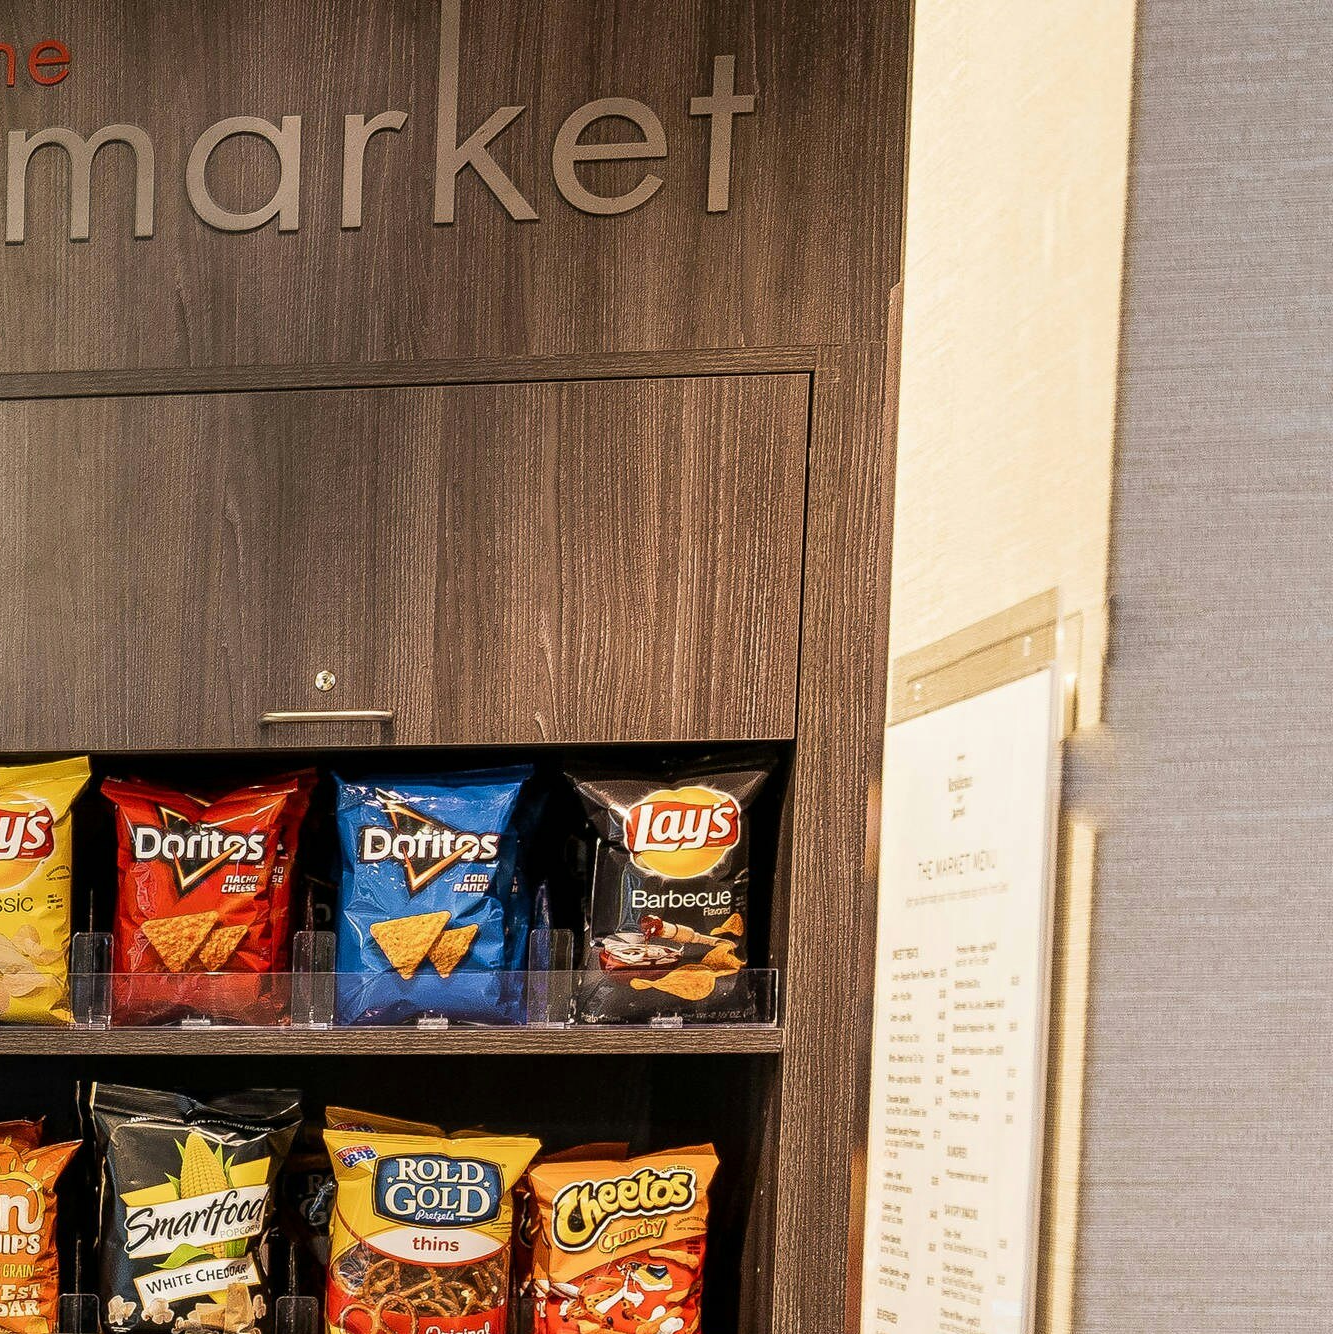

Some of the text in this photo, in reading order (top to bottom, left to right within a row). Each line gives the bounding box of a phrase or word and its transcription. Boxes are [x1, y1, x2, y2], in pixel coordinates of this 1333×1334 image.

[4, 0, 755, 245] market
[634, 802, 735, 853] Lay's
[134, 827, 265, 862] Doritos
[363, 828, 499, 861] Doritos
[221, 883, 257, 893] CHEESE
[225, 875, 259, 884] NACHO
[453, 883, 489, 892] RANCH
[463, 874, 489, 883] COOL
[632, 889, 732, 909] Barbecue
[703, 906, 731, 915] Flavored
[396, 1159, 484, 1183] ROLD
[385, 1182, 490, 1217] GOLD
[416, 1211, 454, 1222] Pretzels
[554, 1170, 695, 1251] Cheetos
[125, 1190, 266, 1254] Smartfood
[413, 1237, 459, 1252] thins
[598, 1218, 665, 1253] Crunchy
[3, 1264, 34, 1277] GRAIN
[146, 1273, 193, 1294] WHITE
